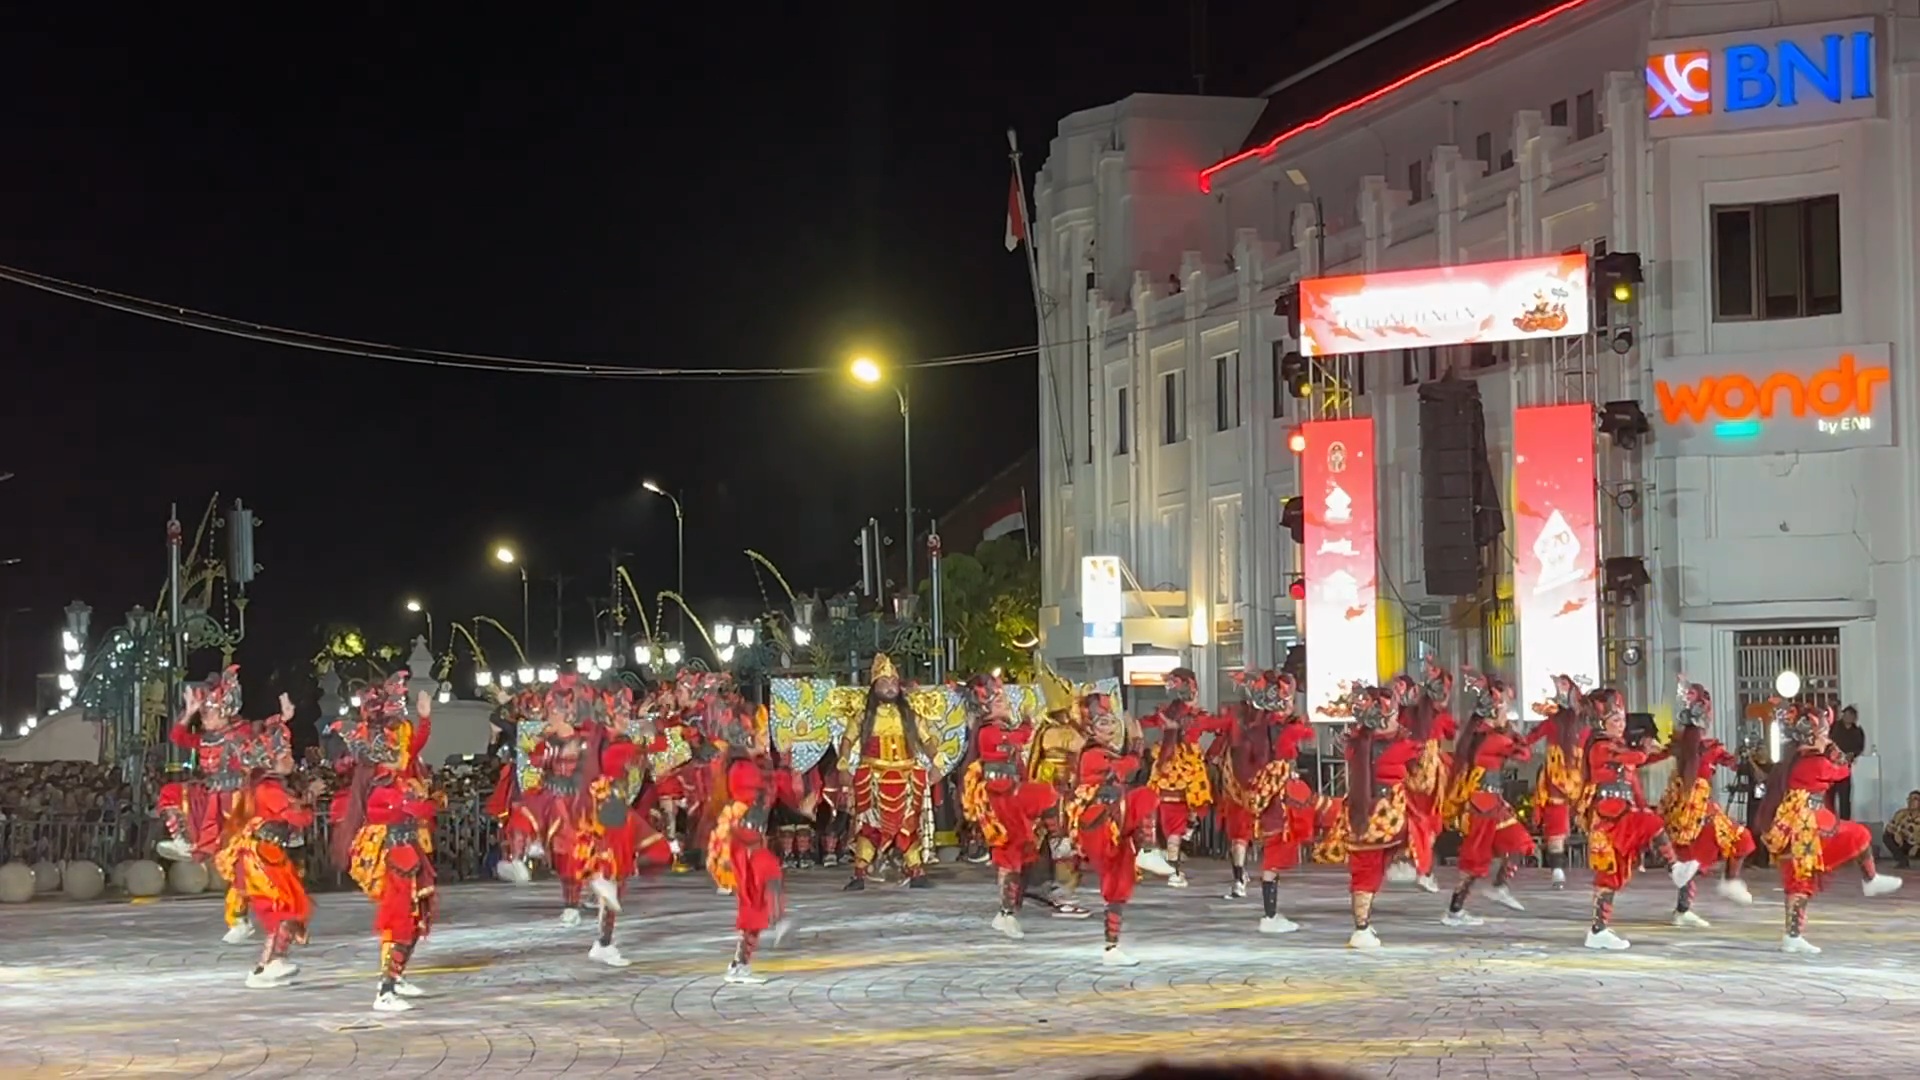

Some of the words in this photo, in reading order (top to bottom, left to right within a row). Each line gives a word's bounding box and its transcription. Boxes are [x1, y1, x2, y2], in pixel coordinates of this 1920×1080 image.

[1723, 31, 1874, 113] BNI
[1655, 353, 1890, 425] wondr
[1818, 418, 1838, 435] by
